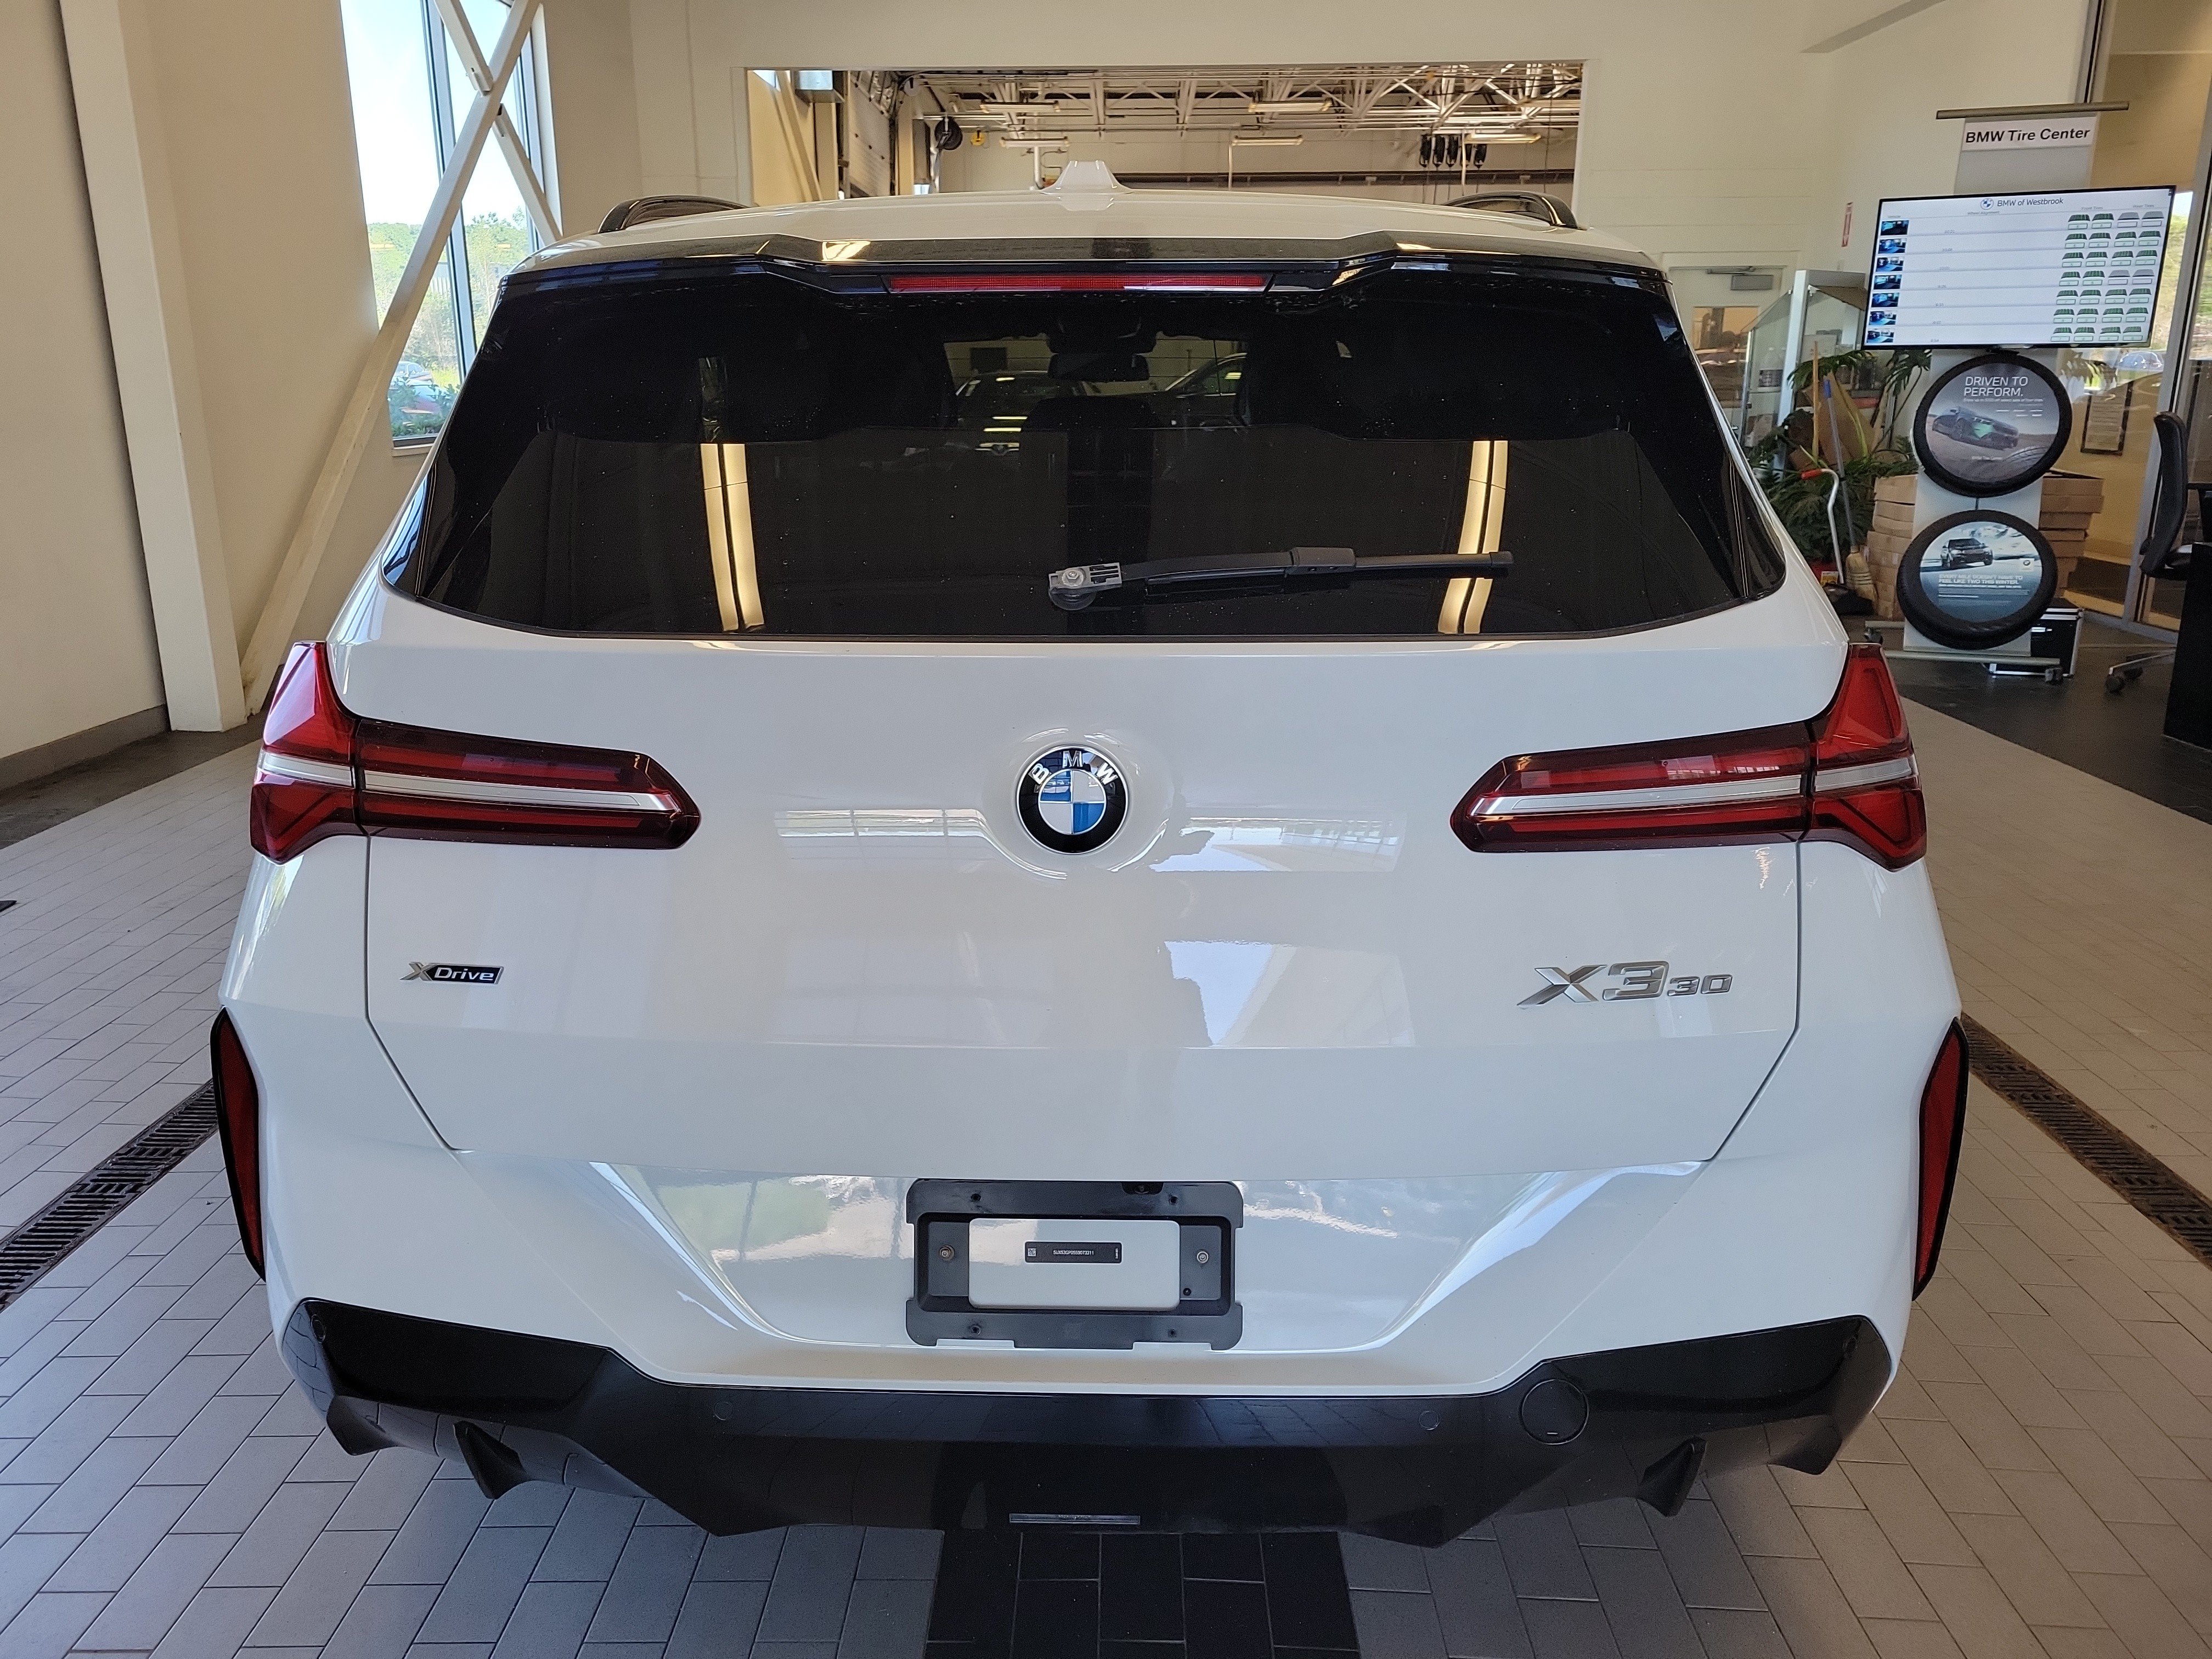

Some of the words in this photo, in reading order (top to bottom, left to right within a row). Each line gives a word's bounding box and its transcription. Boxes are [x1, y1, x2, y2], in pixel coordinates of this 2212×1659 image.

[1966, 131, 2005, 143] BMW
[2008, 129, 2036, 141] Tire
[2040, 128, 2091, 140] Center
[1965, 376, 2008, 386] DRIVEN
[2012, 376, 2028, 386] TO
[1964, 387, 2023, 397] PERFORM.
[1028, 750, 1118, 785] BMW
[1516, 961, 1669, 1006] X3
[1667, 974, 1733, 997] 30
